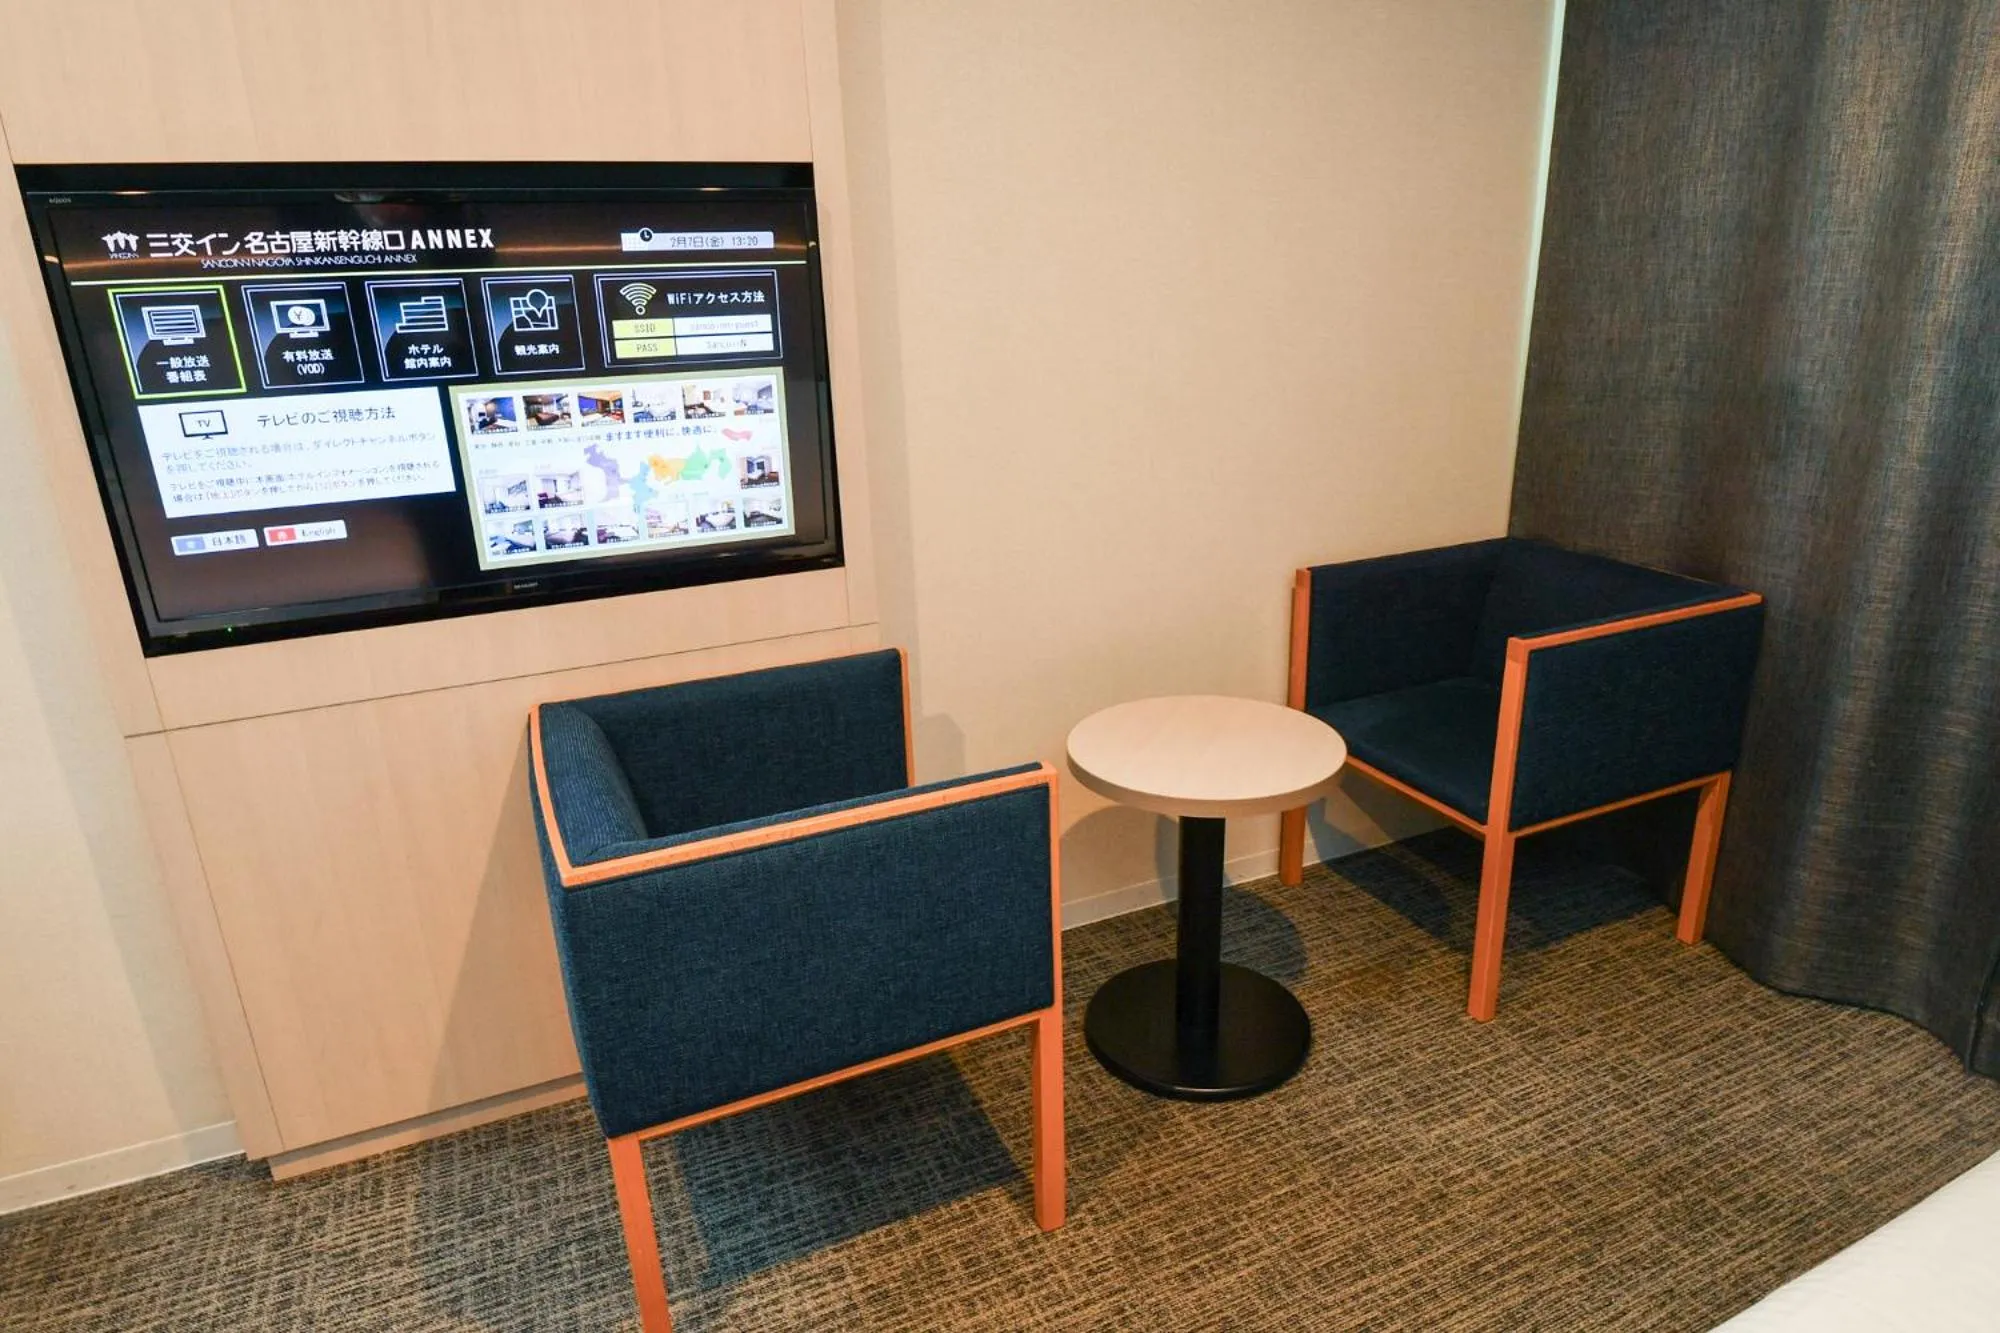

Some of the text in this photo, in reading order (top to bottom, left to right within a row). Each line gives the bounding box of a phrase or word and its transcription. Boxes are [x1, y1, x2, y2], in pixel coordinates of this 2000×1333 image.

[146, 228, 495, 258] 三交イン 名古屋新幹線口 ANNEX
[732, 235, 759, 246] 13:20
[384, 254, 417, 264] ANNEX
[666, 290, 765, 305] WiFiアクセス方法
[634, 324, 656, 334] SSID
[408, 344, 444, 355] ホテル
[514, 344, 560, 357] 観光案内
[636, 343, 658, 353] PASS
[282, 348, 334, 362] 有料放送
[156, 355, 211, 370] 一般放送
[296, 363, 325, 375] (VOD)
[403, 356, 452, 369] 館内案内
[166, 369, 208, 384] 番組表
[256, 405, 396, 428] テレビのご視聴方法
[197, 419, 211, 428] TV
[211, 534, 247, 547] 日本語
